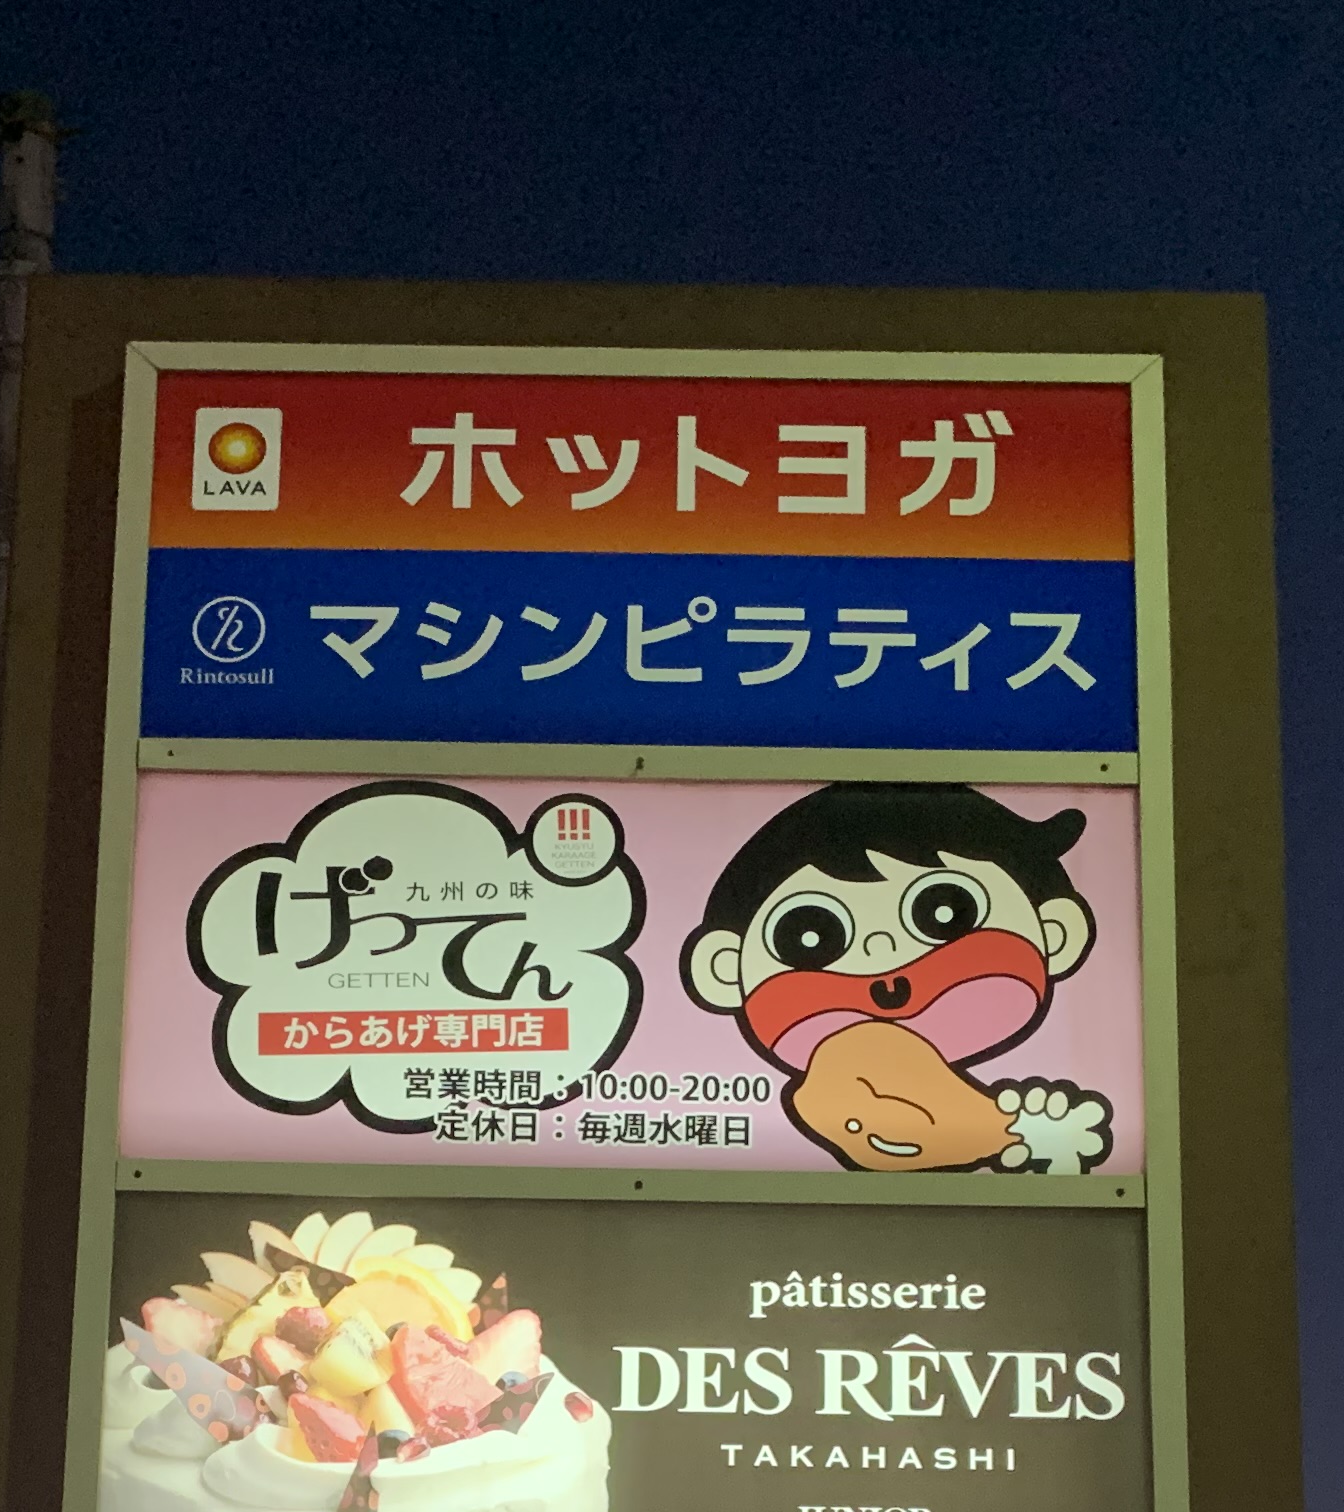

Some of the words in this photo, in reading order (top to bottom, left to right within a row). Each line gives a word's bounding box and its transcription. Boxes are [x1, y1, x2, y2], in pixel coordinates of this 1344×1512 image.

[400, 410, 1014, 516] ホットヨガ
[203, 480, 267, 496] LAVA
[309, 595, 1097, 692] マシンピラティス
[180, 667, 274, 685] Rintosull
[554, 860, 595, 869] GETTEN
[406, 879, 534, 902] 九州の味
[328, 971, 430, 989] GETTEN
[283, 1013, 546, 1050] からあげ専門店
[749, 1270, 986, 1318] pâtisserie
[611, 1346, 793, 1415] DES
[814, 1333, 1126, 1421] RÊVES
[720, 1444, 1015, 1471] TAKAHASHI
